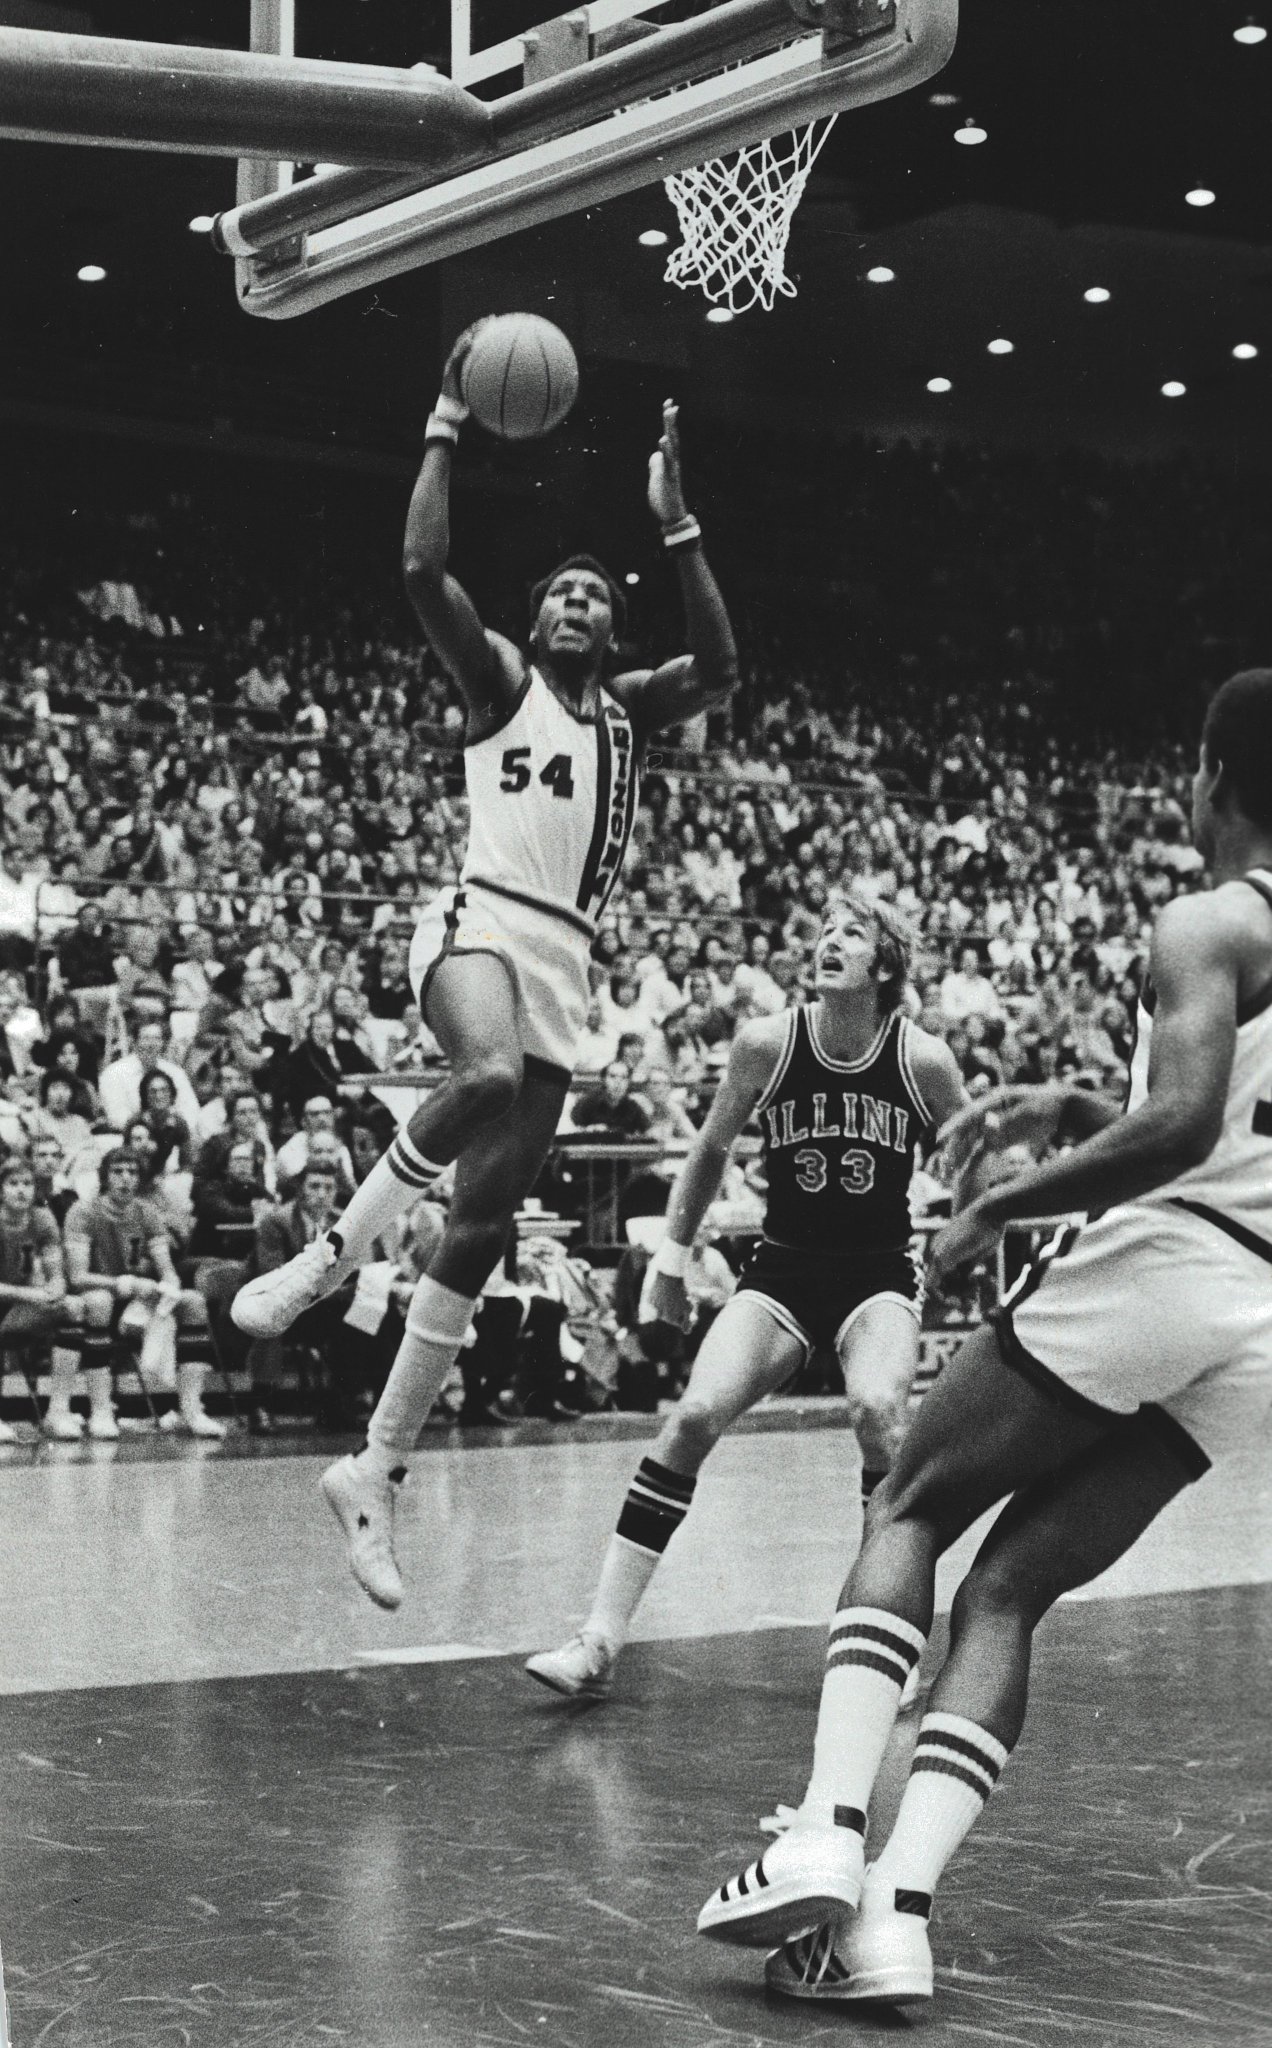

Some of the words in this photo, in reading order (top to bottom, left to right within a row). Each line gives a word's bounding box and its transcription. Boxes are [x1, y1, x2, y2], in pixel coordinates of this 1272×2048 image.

[500, 747, 574, 800] 54
[766, 1092, 909, 1154] ILLINI
[794, 1148, 876, 1195] 33
